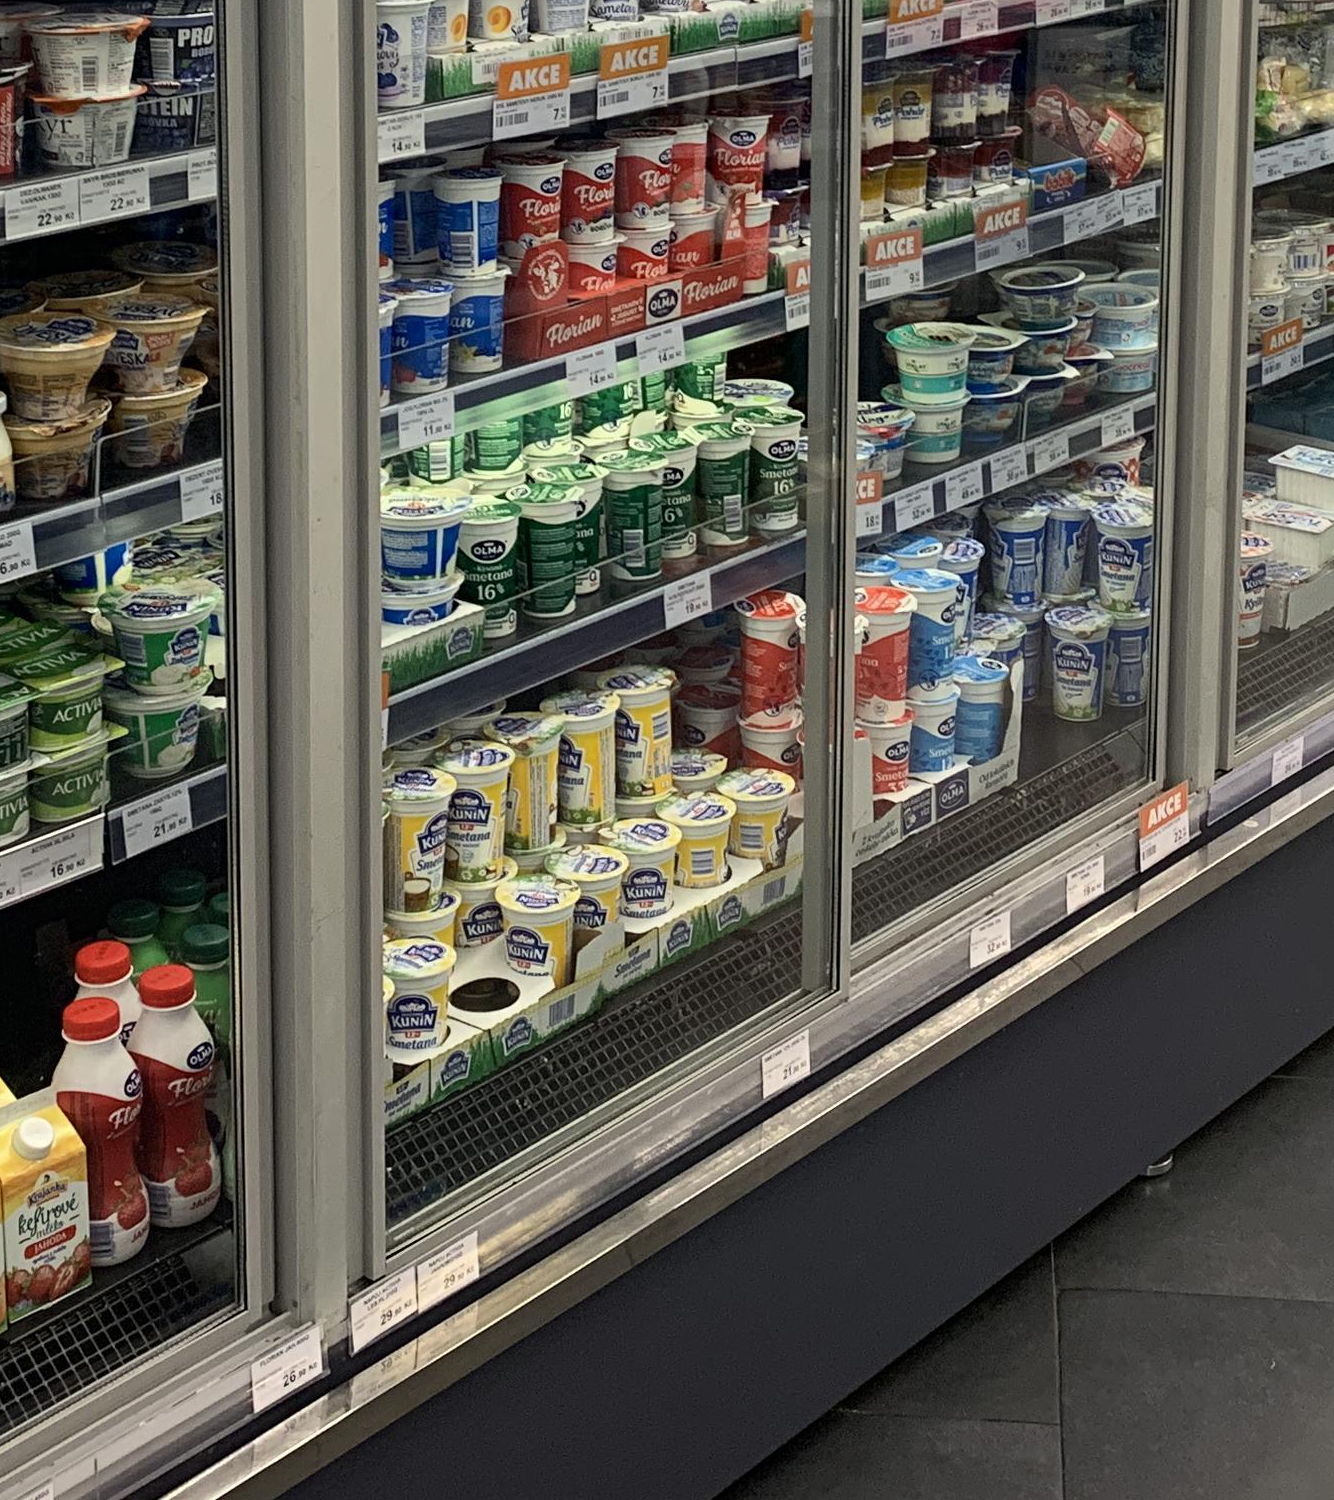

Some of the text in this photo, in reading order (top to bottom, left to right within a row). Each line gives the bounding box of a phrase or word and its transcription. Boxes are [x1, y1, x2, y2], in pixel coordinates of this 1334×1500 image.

[611, 44, 659, 73] AKCE
[509, 64, 560, 93] AKCE
[730, 133, 756, 144] OLMA
[983, 206, 1021, 235] AKCE
[875, 235, 916, 262] AKCE
[683, 274, 740, 304] Florian
[648, 294, 679, 314] OLMA
[545, 314, 604, 347] Florian
[1268, 325, 1299, 351] AKCE
[770, 442, 796, 457] OLMA
[473, 544, 506, 557] OLMA
[941, 785, 965, 804] OLMA
[1147, 791, 1183, 830] AKCE
[388, 1033, 438, 1050] Smetana
[27, 1182, 68, 1207] Krajanka
[18, 1193, 79, 1239] kefírové
